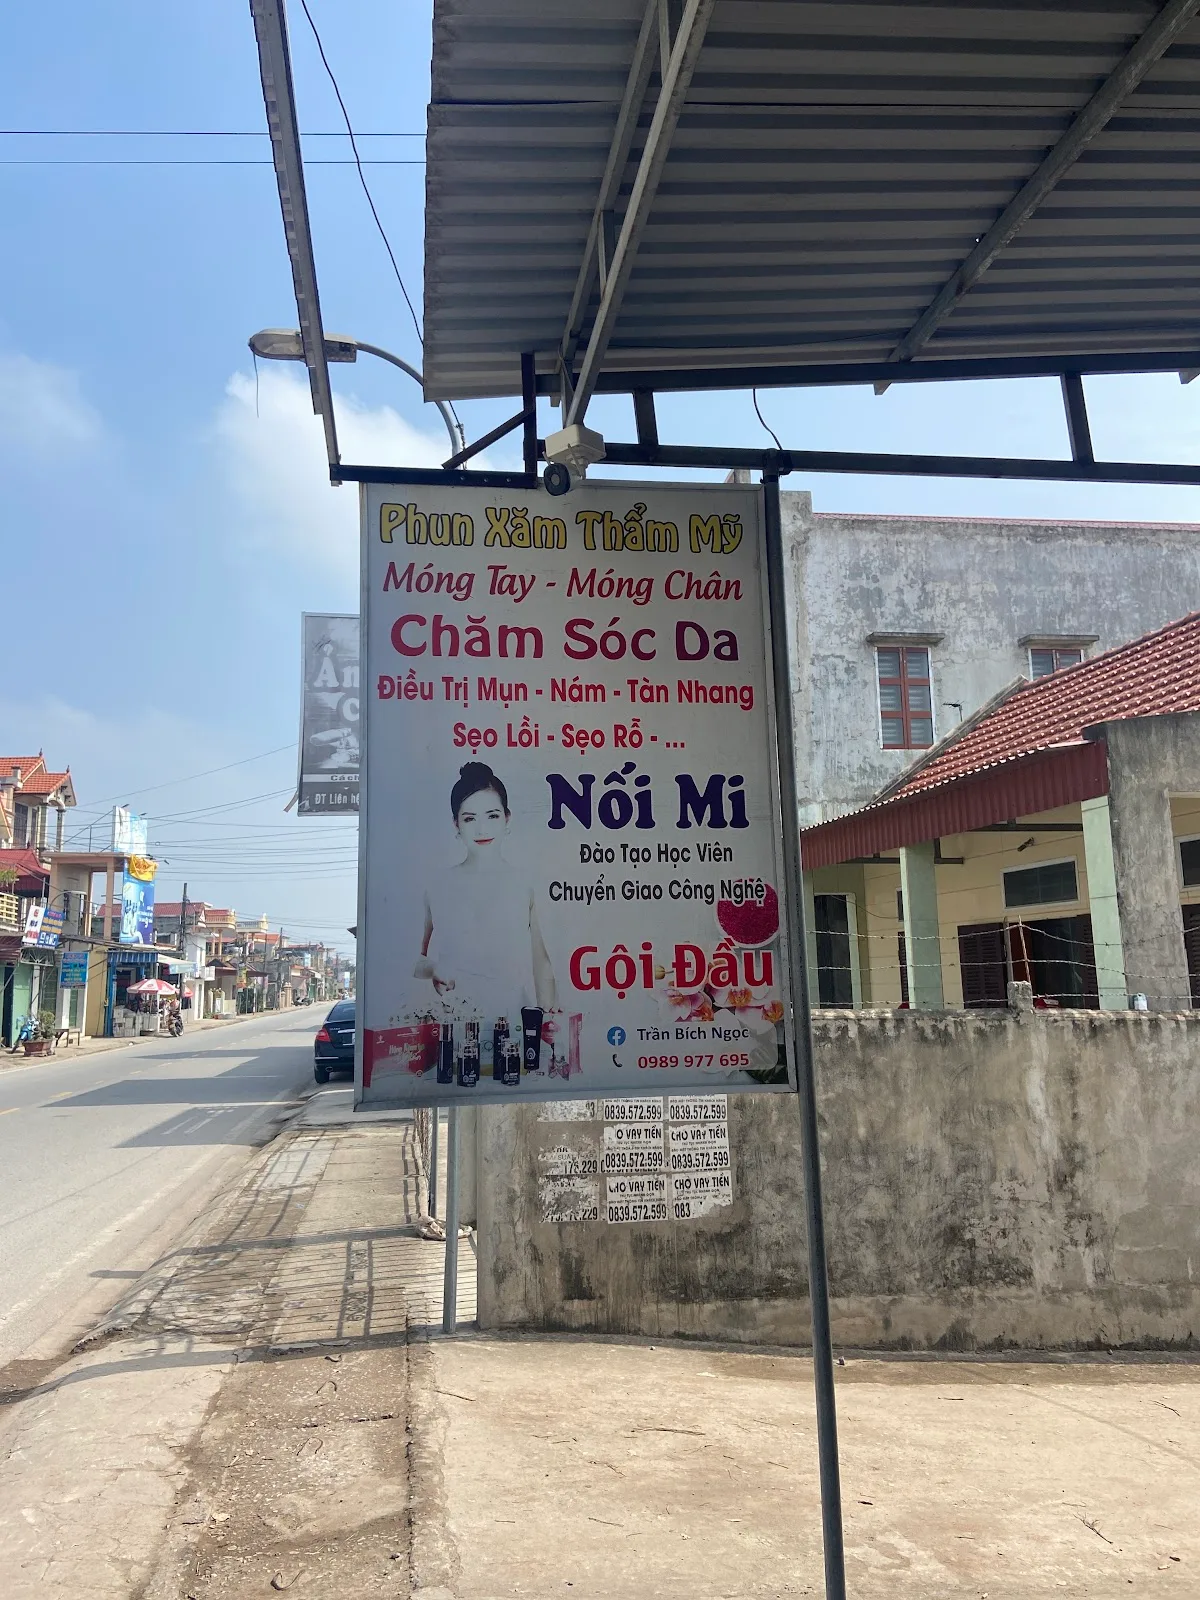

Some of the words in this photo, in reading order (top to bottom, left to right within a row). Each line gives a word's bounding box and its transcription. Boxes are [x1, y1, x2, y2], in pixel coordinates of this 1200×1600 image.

[380, 502, 475, 547] Phun
[484, 506, 567, 550] Xăm
[575, 502, 680, 553] Thẩm
[689, 513, 743, 554] Mỹ
[382, 562, 475, 601] Móng
[487, 564, 536, 603] Tay
[566, 566, 654, 606] Móng
[664, 569, 743, 601] Chân
[390, 614, 544, 659] Chăm
[563, 616, 657, 661] Sóc
[675, 620, 739, 662] Da
[377, 668, 433, 702] Điều
[442, 676, 469, 708] Trị
[477, 677, 528, 709] Mụn
[550, 676, 606, 702] Nám
[627, 677, 670, 704] Tàn
[677, 680, 754, 711] Nhang
[453, 722, 498, 754] Sẹo
[506, 715, 540, 749] Lồi
[561, 723, 605, 755] Sẹo
[613, 718, 643, 749] Rỗ
[545, 761, 656, 830] Nối
[675, 773, 750, 830] Mi
[580, 841, 615, 864] Đào
[620, 843, 652, 868] Tạo
[657, 843, 691, 868] Học
[696, 841, 733, 862] Viên
[549, 873, 616, 905] Chuyển
[621, 880, 663, 900] Giao
[668, 879, 715, 905] Công
[720, 878, 765, 905] Nghệ
[569, 941, 654, 1000] Gội
[671, 937, 774, 989] Đầu
[637, 1026, 670, 1041] Trần
[675, 1026, 706, 1040] Bích
[711, 1026, 749, 1041] Ngọc
[638, 1056, 679, 1069] 0989
[684, 1055, 714, 1068] 977
[719, 1053, 749, 1067] 695
[604, 1104, 662, 1120] 0839.572.599
[670, 1104, 727, 1120] 0839.572.599
[625, 1128, 642, 1140] VAY
[690, 1129, 706, 1141] VAY
[605, 1151, 663, 1168] 0839.572.599
[671, 1151, 729, 1170] 0839.572.599
[628, 1180, 645, 1192] VAY
[693, 1177, 710, 1189] VAY
[608, 1203, 667, 1222] 0839.572.599
